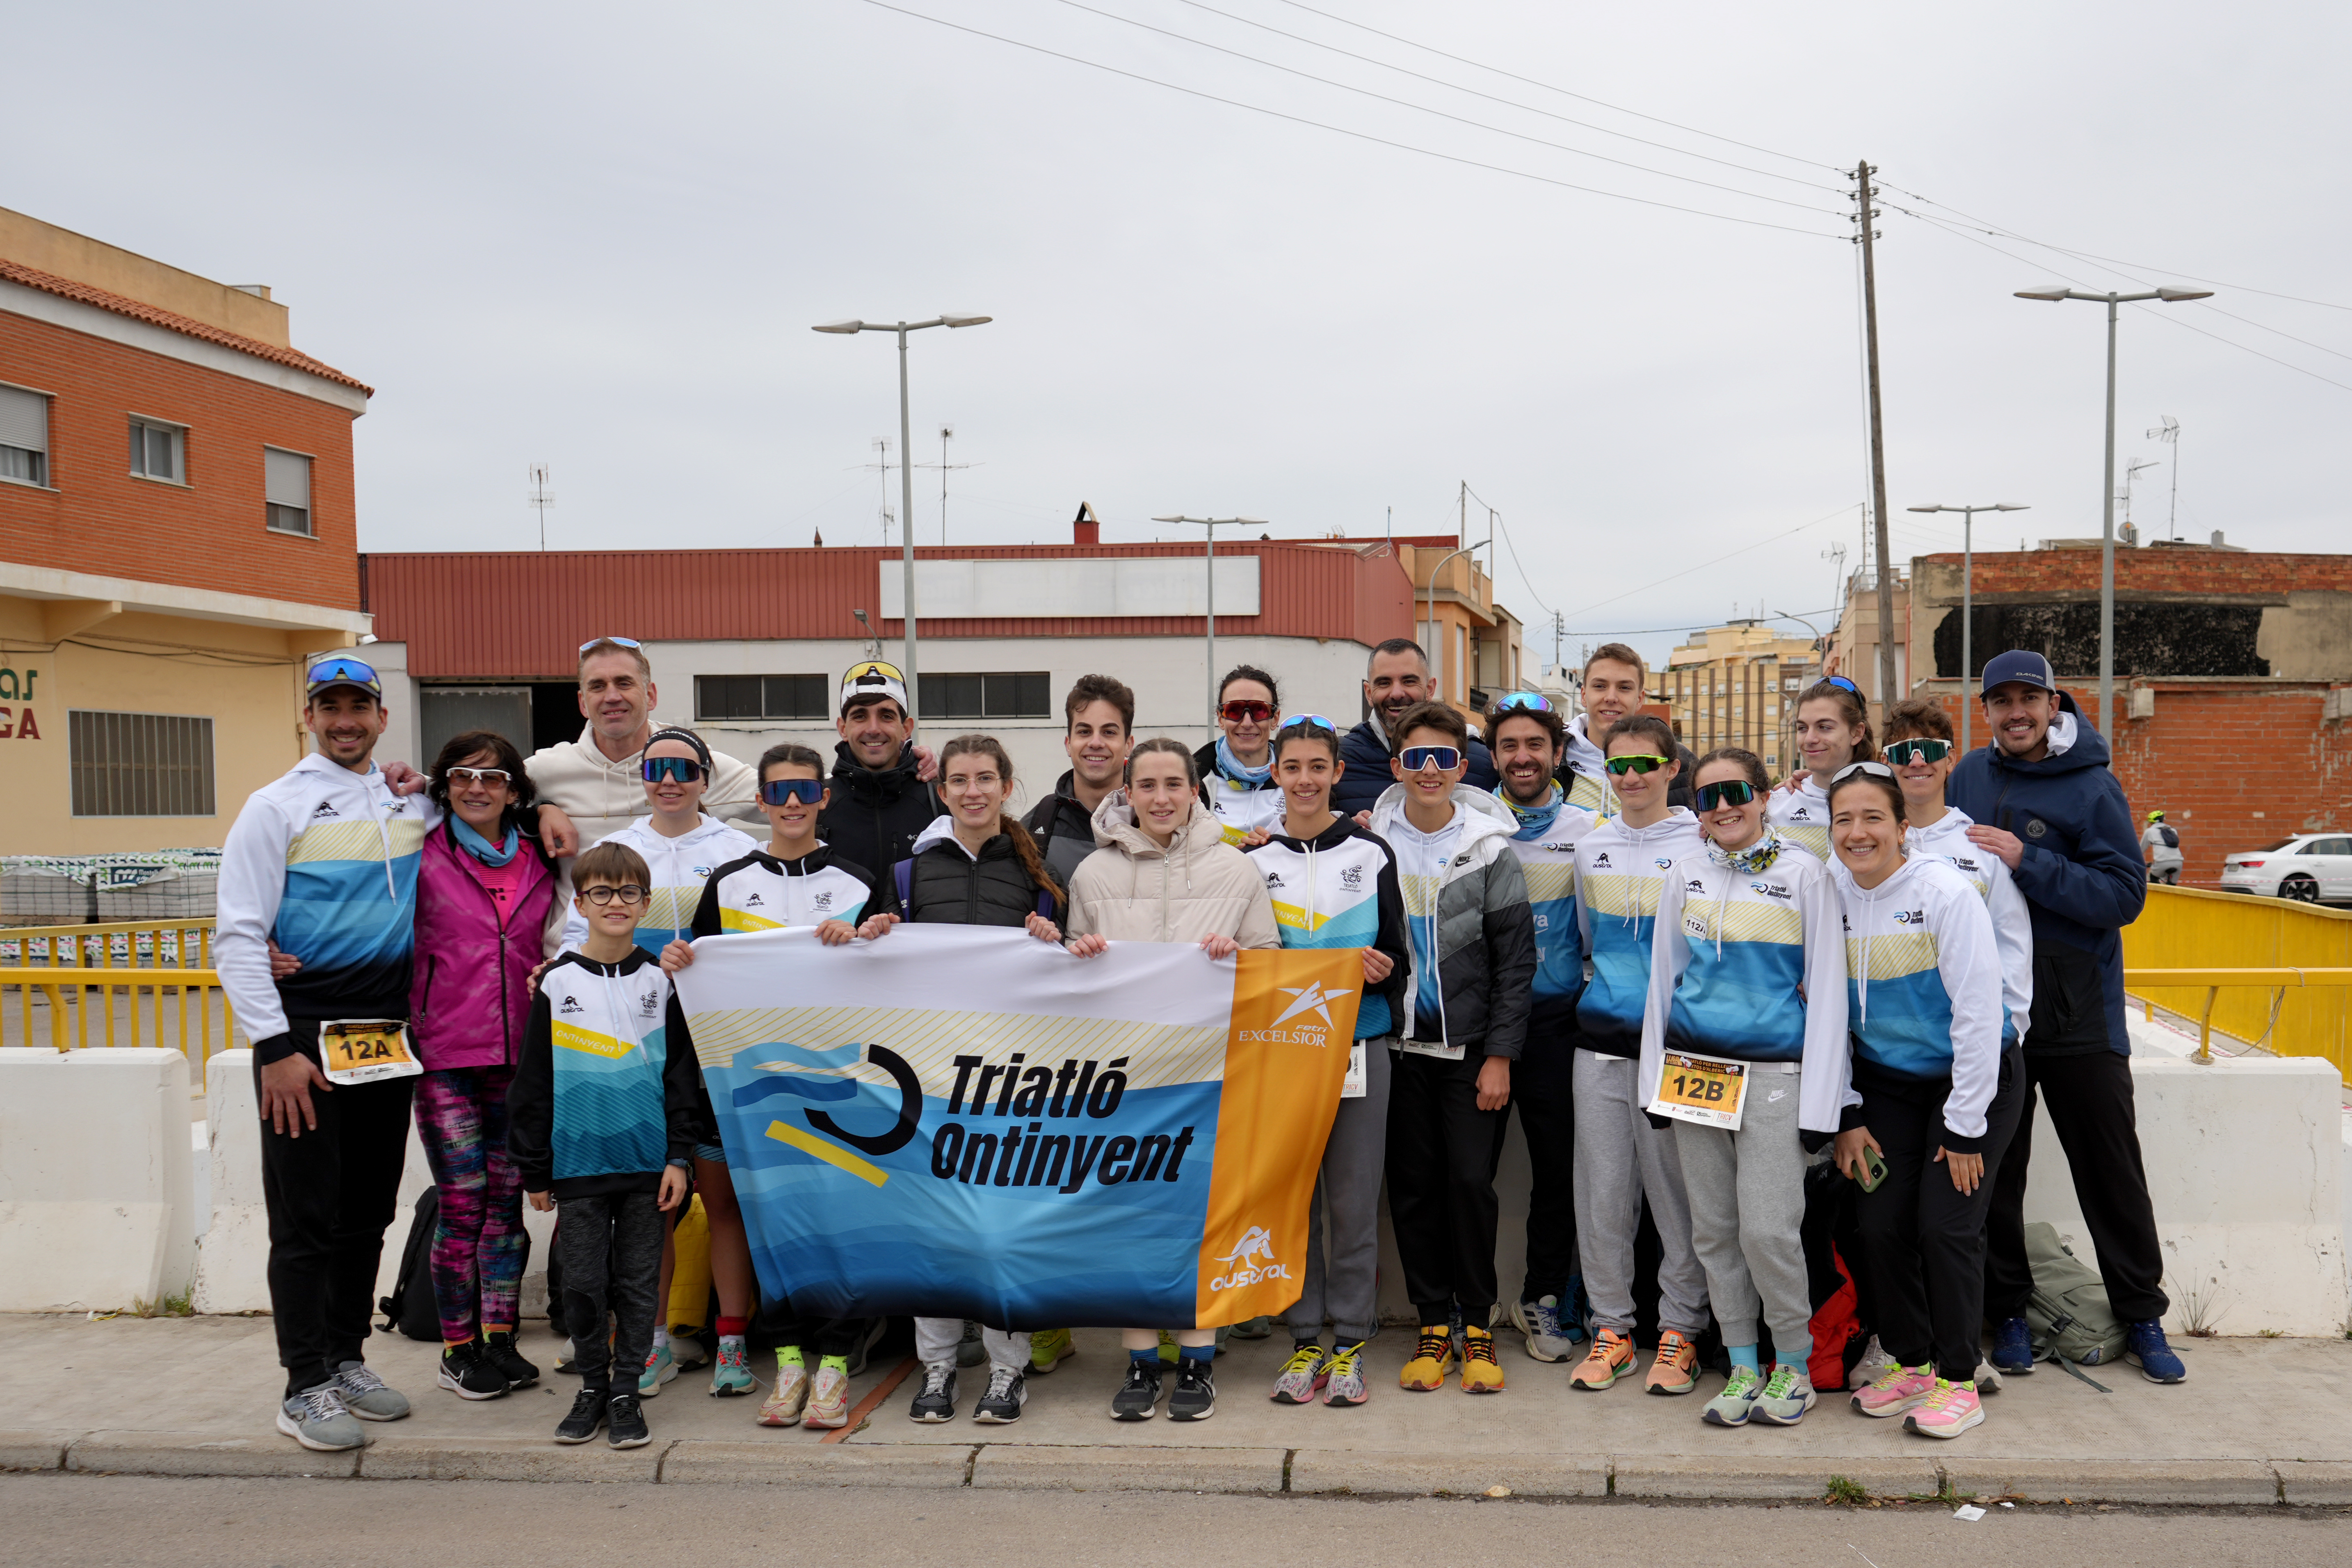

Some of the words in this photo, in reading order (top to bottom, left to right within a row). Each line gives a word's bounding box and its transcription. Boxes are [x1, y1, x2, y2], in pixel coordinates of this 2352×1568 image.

[2016, 672, 2044, 680] DAKINE
[1767, 890, 1792, 900] Ontinyent
[339, 1040, 394, 1060] 12A
[556, 1030, 615, 1054] ONTINYENT
[1239, 1029, 1326, 1048] EXCELSIOR
[947, 1052, 1130, 1118] Triatló
[1674, 1075, 1724, 1101] 12B
[931, 1122, 1194, 1194] Ontinyent
[1210, 1264, 1292, 1291] austral
